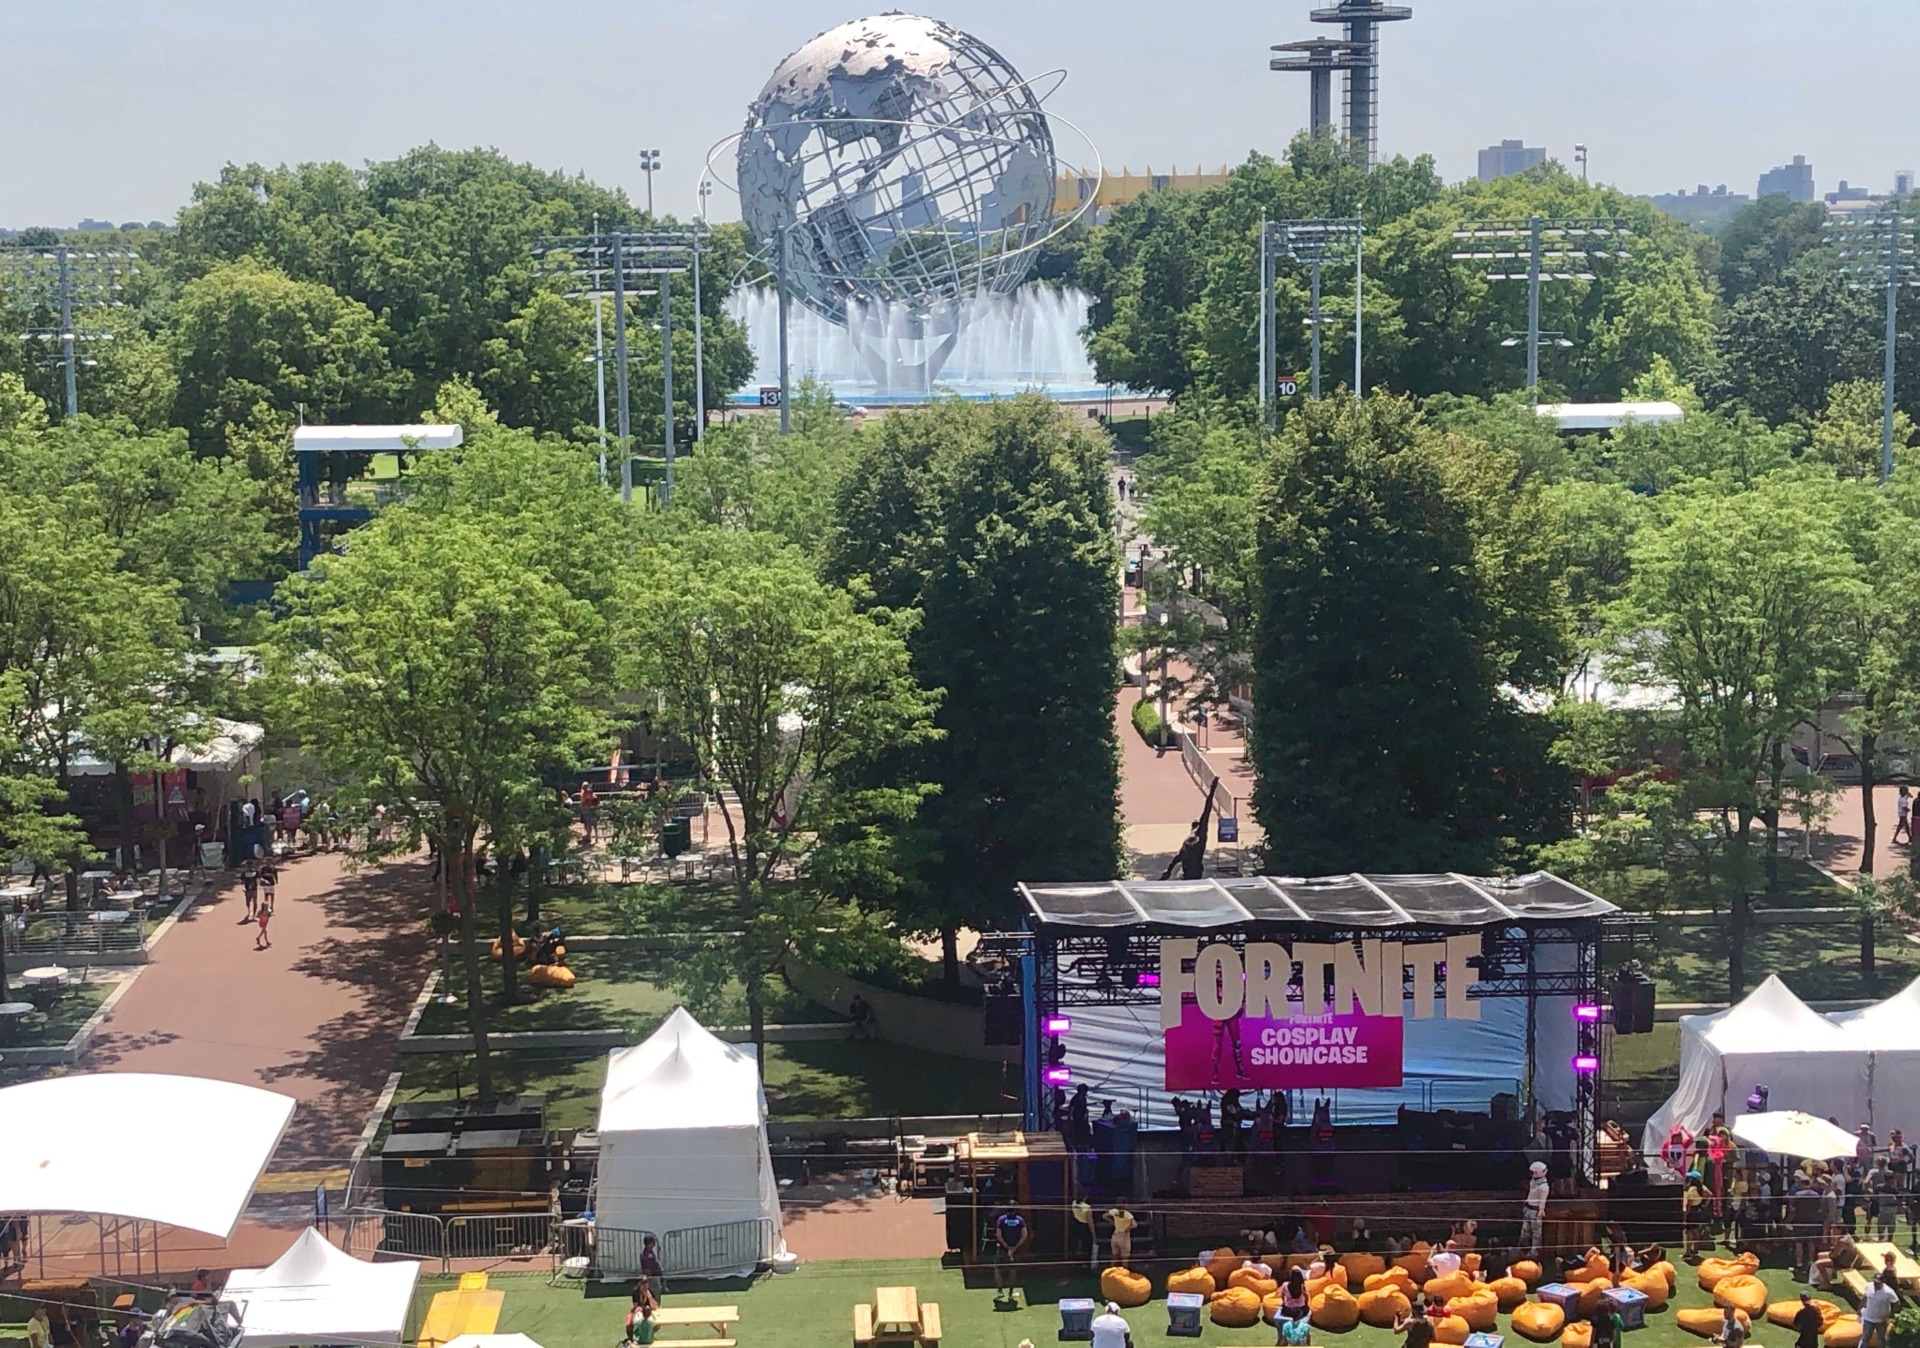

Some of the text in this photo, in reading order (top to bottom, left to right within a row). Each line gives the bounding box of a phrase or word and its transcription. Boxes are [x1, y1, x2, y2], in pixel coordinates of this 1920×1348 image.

[761, 391, 778, 405] 13
[1279, 382, 1296, 395] 10
[1160, 933, 1484, 1031] FORTNITE
[1261, 1026, 1358, 1046] COSPLAY
[1250, 1046, 1368, 1065] SHOWCASE
